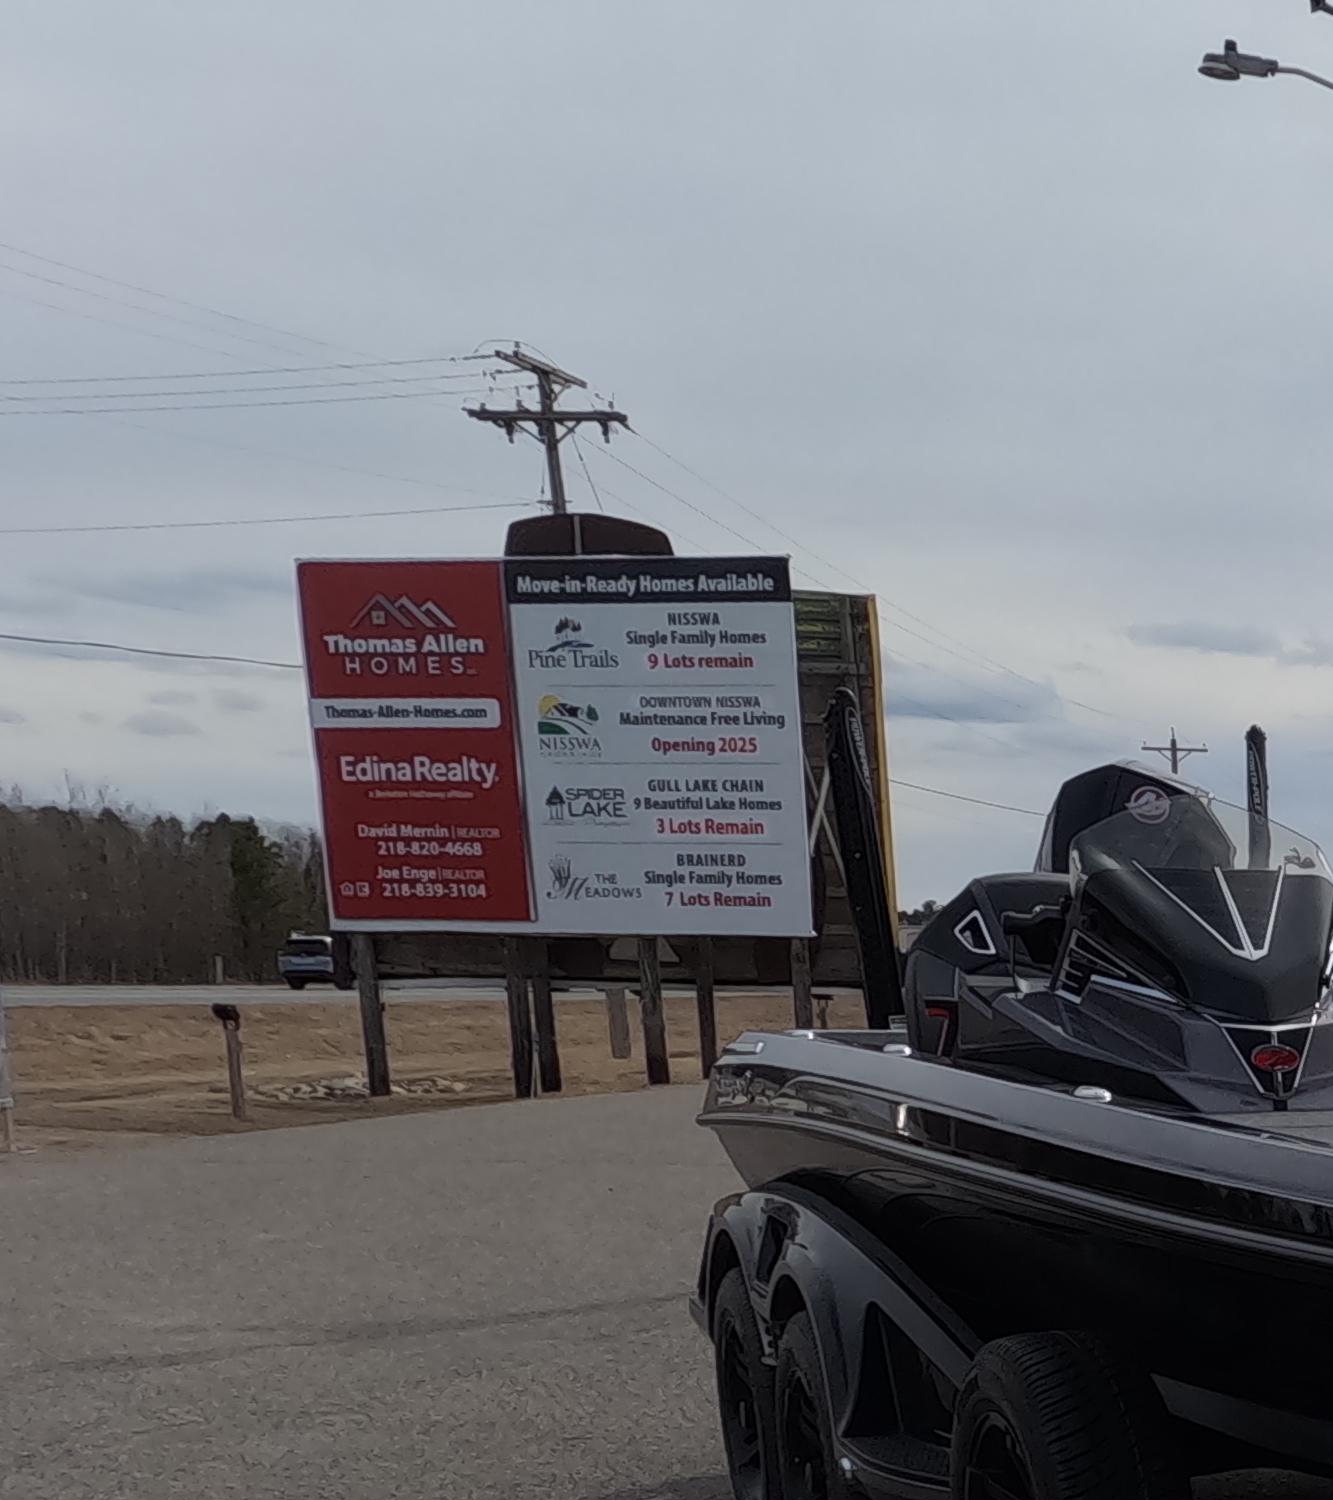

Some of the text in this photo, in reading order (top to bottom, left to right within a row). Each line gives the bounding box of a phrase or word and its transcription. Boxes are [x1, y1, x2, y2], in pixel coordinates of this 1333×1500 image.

[516, 573, 775, 597] Move-in-Ready Homes Available
[667, 612, 721, 626] NISSWA
[323, 633, 485, 653] Thomas Allen
[626, 630, 767, 648] Single Family Homes
[344, 656, 464, 674] HOMES
[528, 650, 620, 669] Pine Trails
[647, 652, 754, 669] 9 Lots remain
[639, 696, 762, 708] DOWNTOWN NISSWA
[324, 705, 488, 719] Thomas-Allen-Homes.com
[619, 711, 786, 729] Maintenance Free Living
[538, 736, 602, 751] NISSWA
[651, 737, 758, 755] Opening 2025
[648, 779, 765, 792] GULL LAKE CHAIN
[564, 787, 625, 800] SPIDER
[567, 801, 629, 818] LAKE
[633, 797, 783, 810] 9 Beautiful Lake Homes
[356, 823, 398, 837] David
[399, 823, 450, 837] Mernin
[656, 818, 765, 834] 3 Lots Remain
[376, 841, 483, 856] 218-820-4668
[676, 853, 746, 867] BRAINERD
[375, 866, 400, 880] Joe
[402, 867, 437, 881] Enge
[594, 873, 618, 884] THE
[644, 871, 783, 888] Single Family Homes
[382, 883, 487, 898] 218-839-3104
[664, 892, 772, 908] 7 Lots Remain
